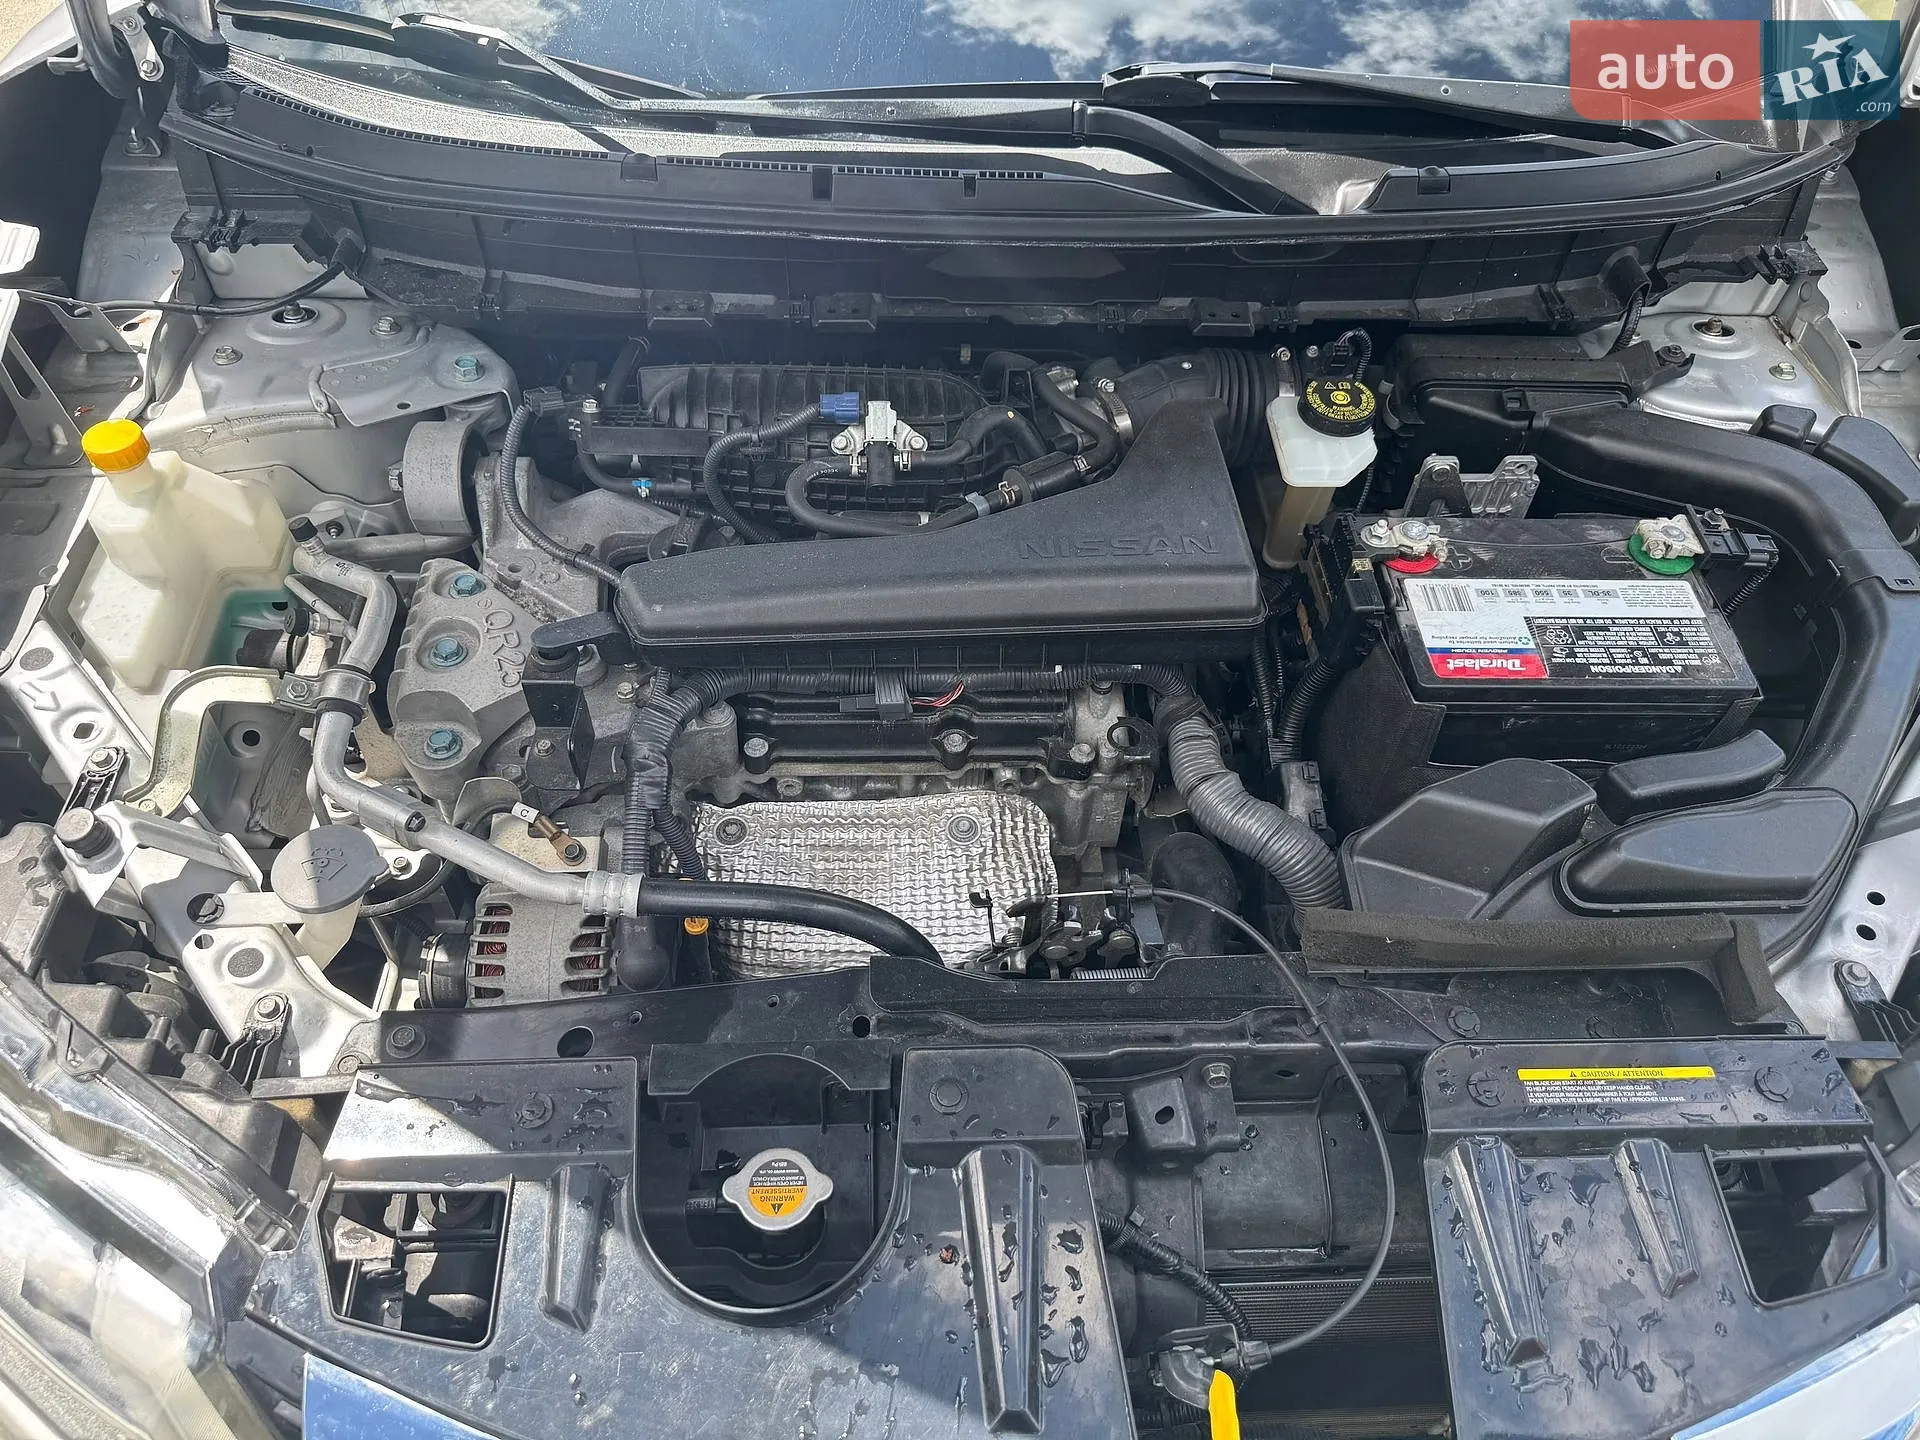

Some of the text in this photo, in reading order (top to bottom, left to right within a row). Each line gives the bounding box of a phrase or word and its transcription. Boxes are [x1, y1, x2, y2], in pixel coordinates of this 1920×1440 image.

[1020, 535, 1220, 559] NISSAN
[1446, 658, 1526, 671] Duralast
[1590, 665, 1675, 673] DANGER/POISON
